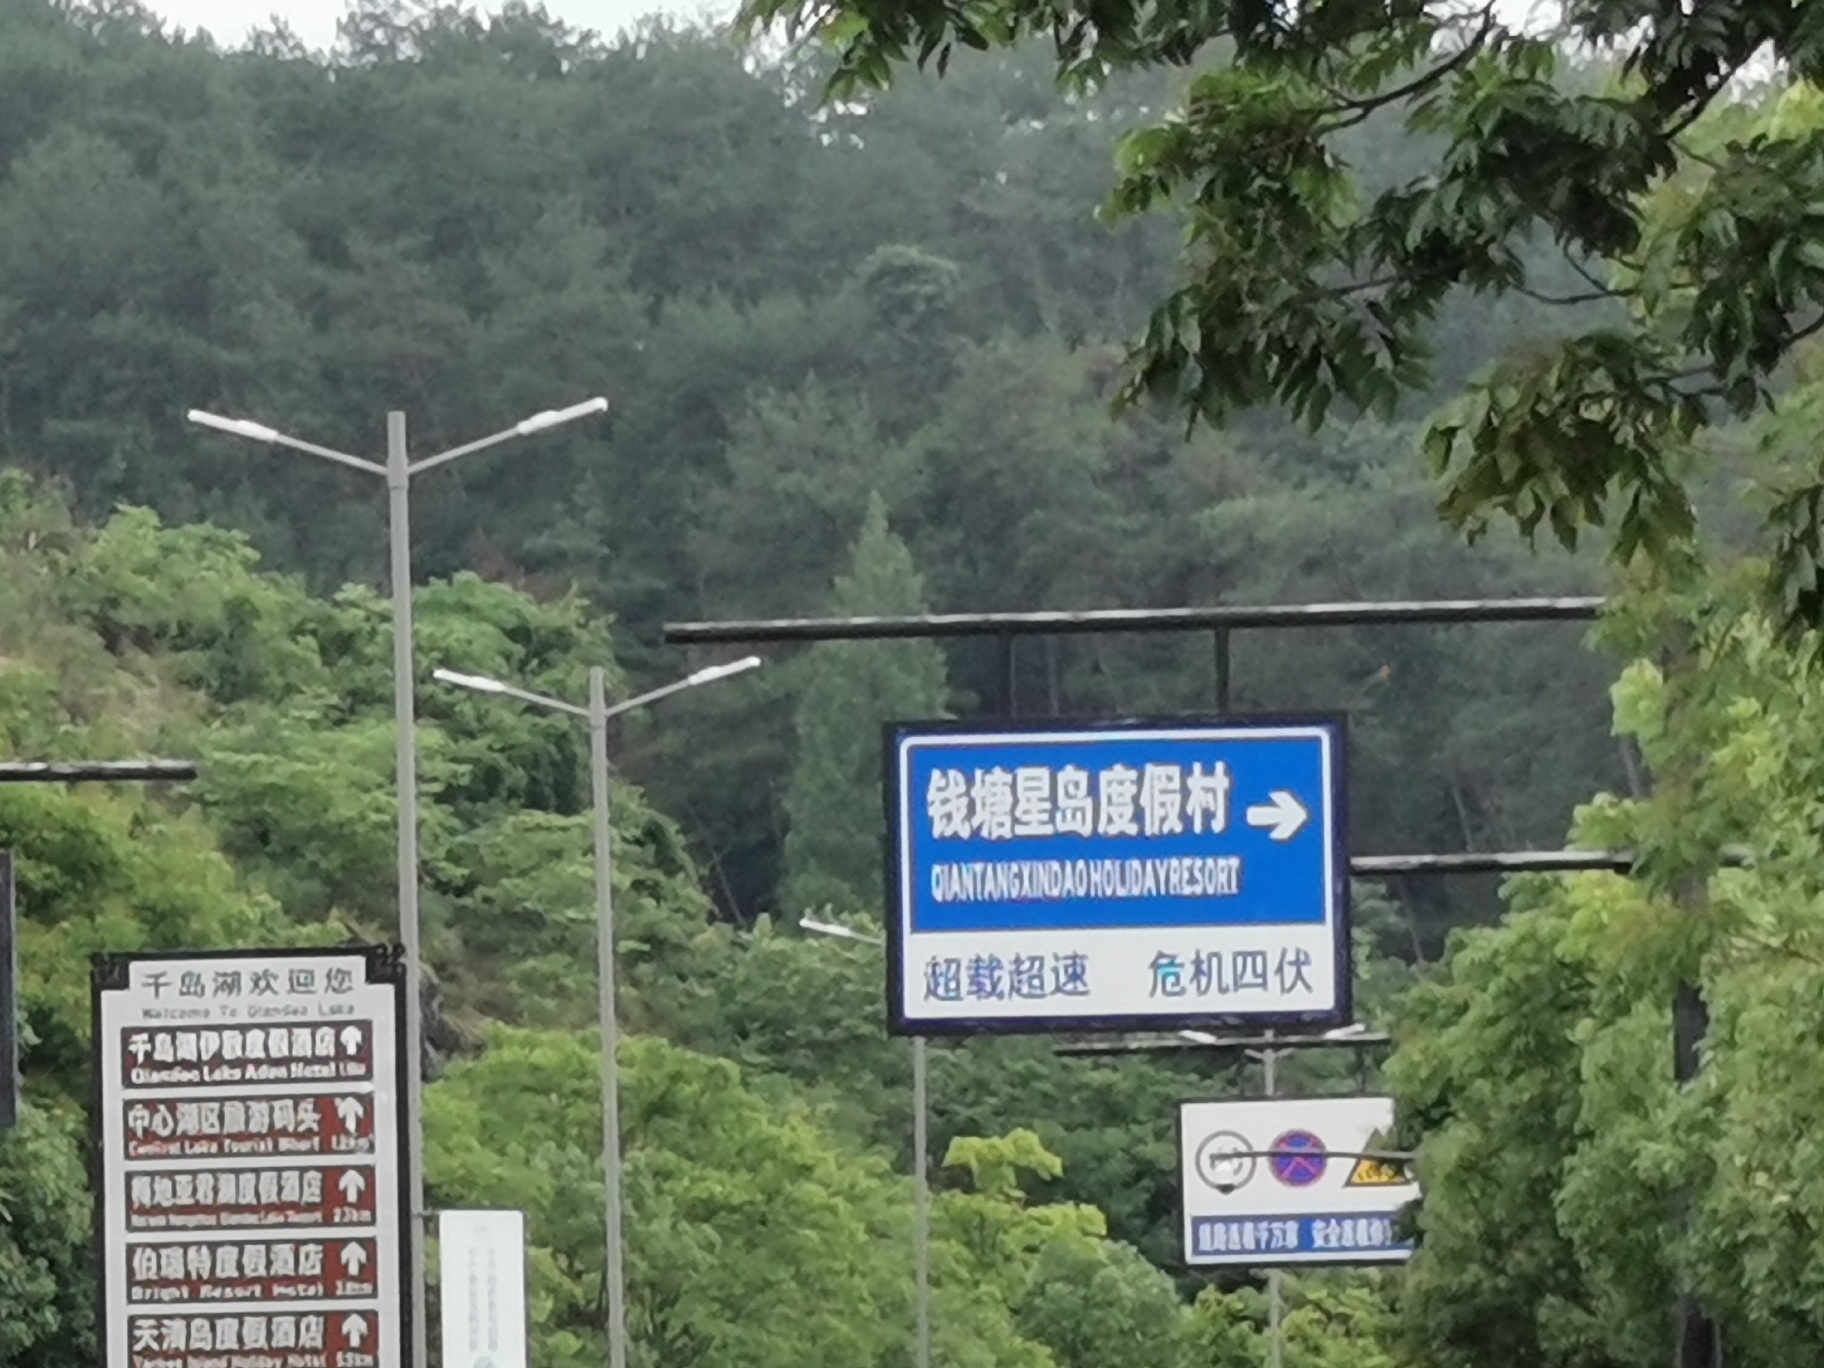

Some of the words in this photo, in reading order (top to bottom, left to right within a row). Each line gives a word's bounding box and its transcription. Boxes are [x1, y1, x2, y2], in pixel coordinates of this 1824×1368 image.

[927, 760, 1232, 840] 钱塘星岛度假村
[141, 967, 355, 999] 千岛湖欢迎您
[923, 952, 1091, 1002] 超载超速
[1148, 946, 1314, 999] 危机四伏
[127, 1098, 322, 1139] 中心湖区旅游码头
[132, 1243, 324, 1281] 伯瑞特度假酒店
